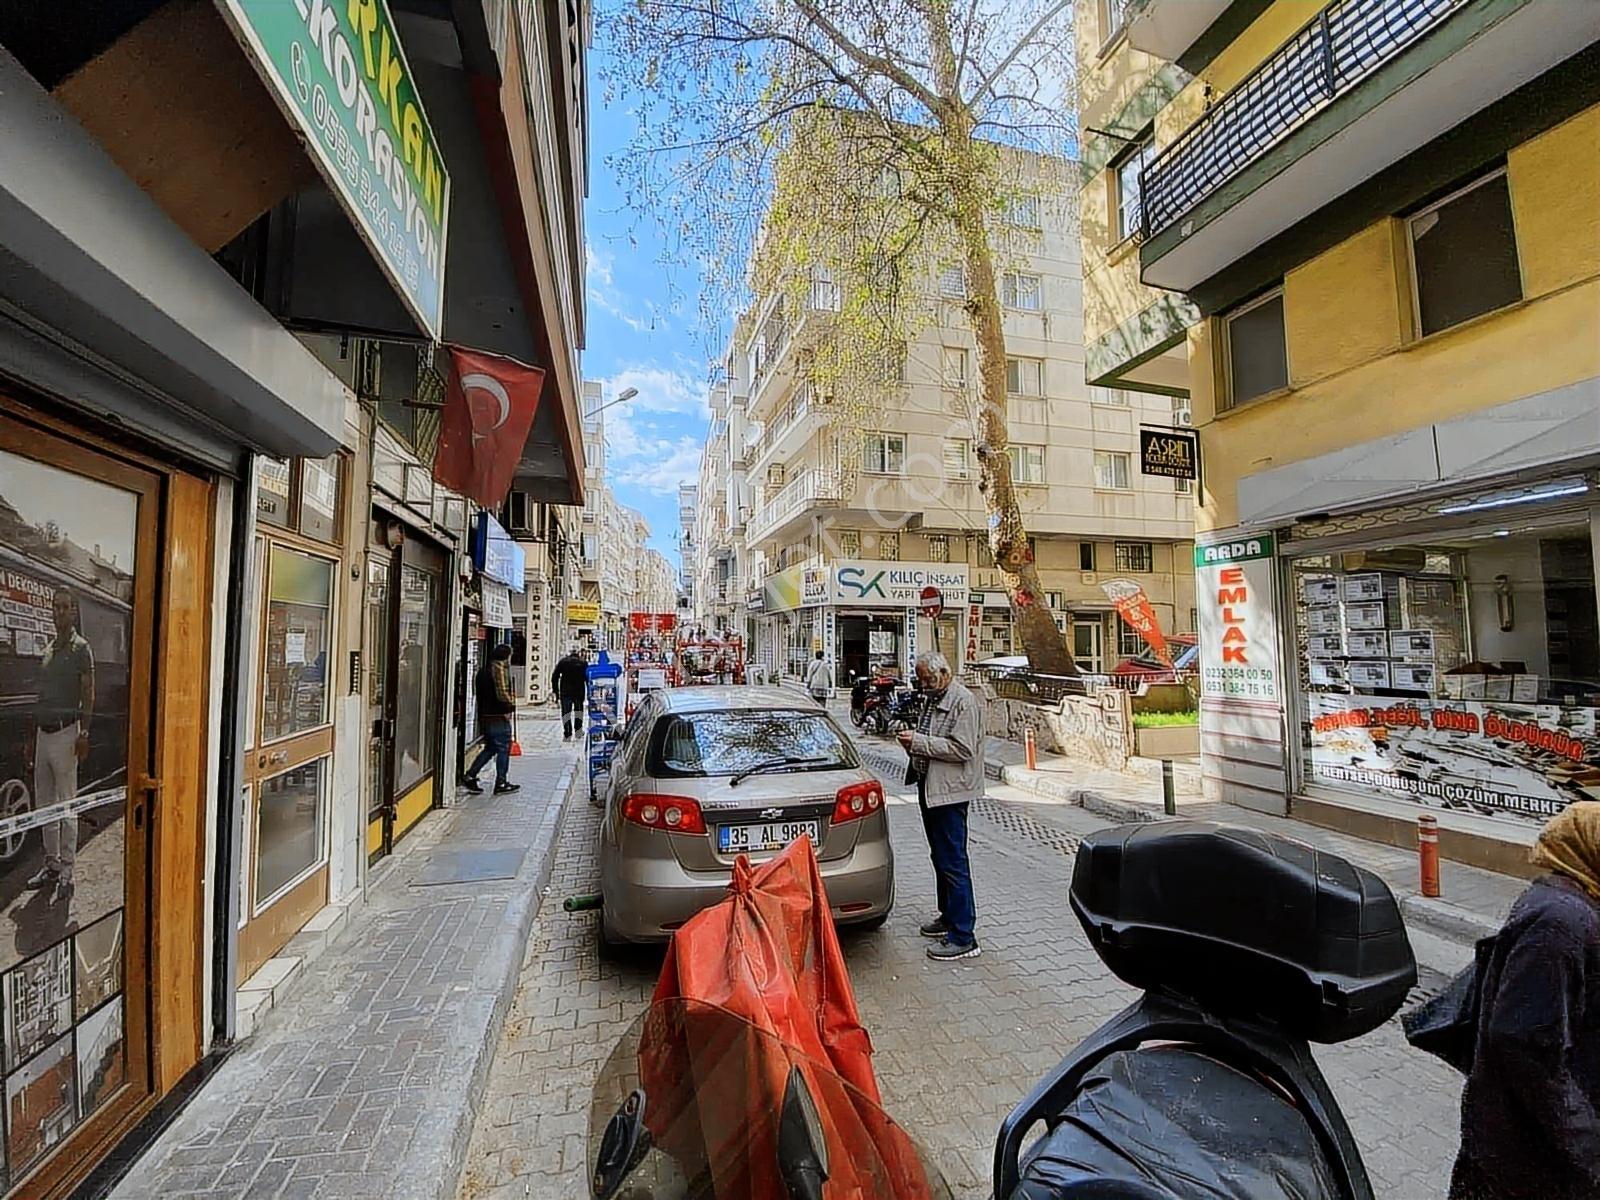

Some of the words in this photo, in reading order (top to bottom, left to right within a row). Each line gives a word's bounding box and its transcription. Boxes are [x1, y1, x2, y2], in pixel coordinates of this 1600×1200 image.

[1204, 540, 1261, 562] ARDA
[8, 571, 56, 601] DEKORASY
[889, 570, 923, 587] KILIÇ
[926, 570, 966, 586] İNŞAAT
[891, 589, 914, 600] YAPI
[1218, 567, 1248, 664] EMLAK
[966, 605, 979, 661] EMLAK
[1205, 667, 1226, 679] 0232
[1260, 669, 1273, 681] 50
[1247, 683, 1259, 695] 75
[1431, 705, 1480, 734] BİNA
[1322, 765, 1372, 784] KENTSEL
[1445, 783, 1499, 806] ÇÖZÜM
[1504, 794, 1565, 814] MERKE
[731, 827, 749, 845] 35
[761, 825, 778, 843] AL
